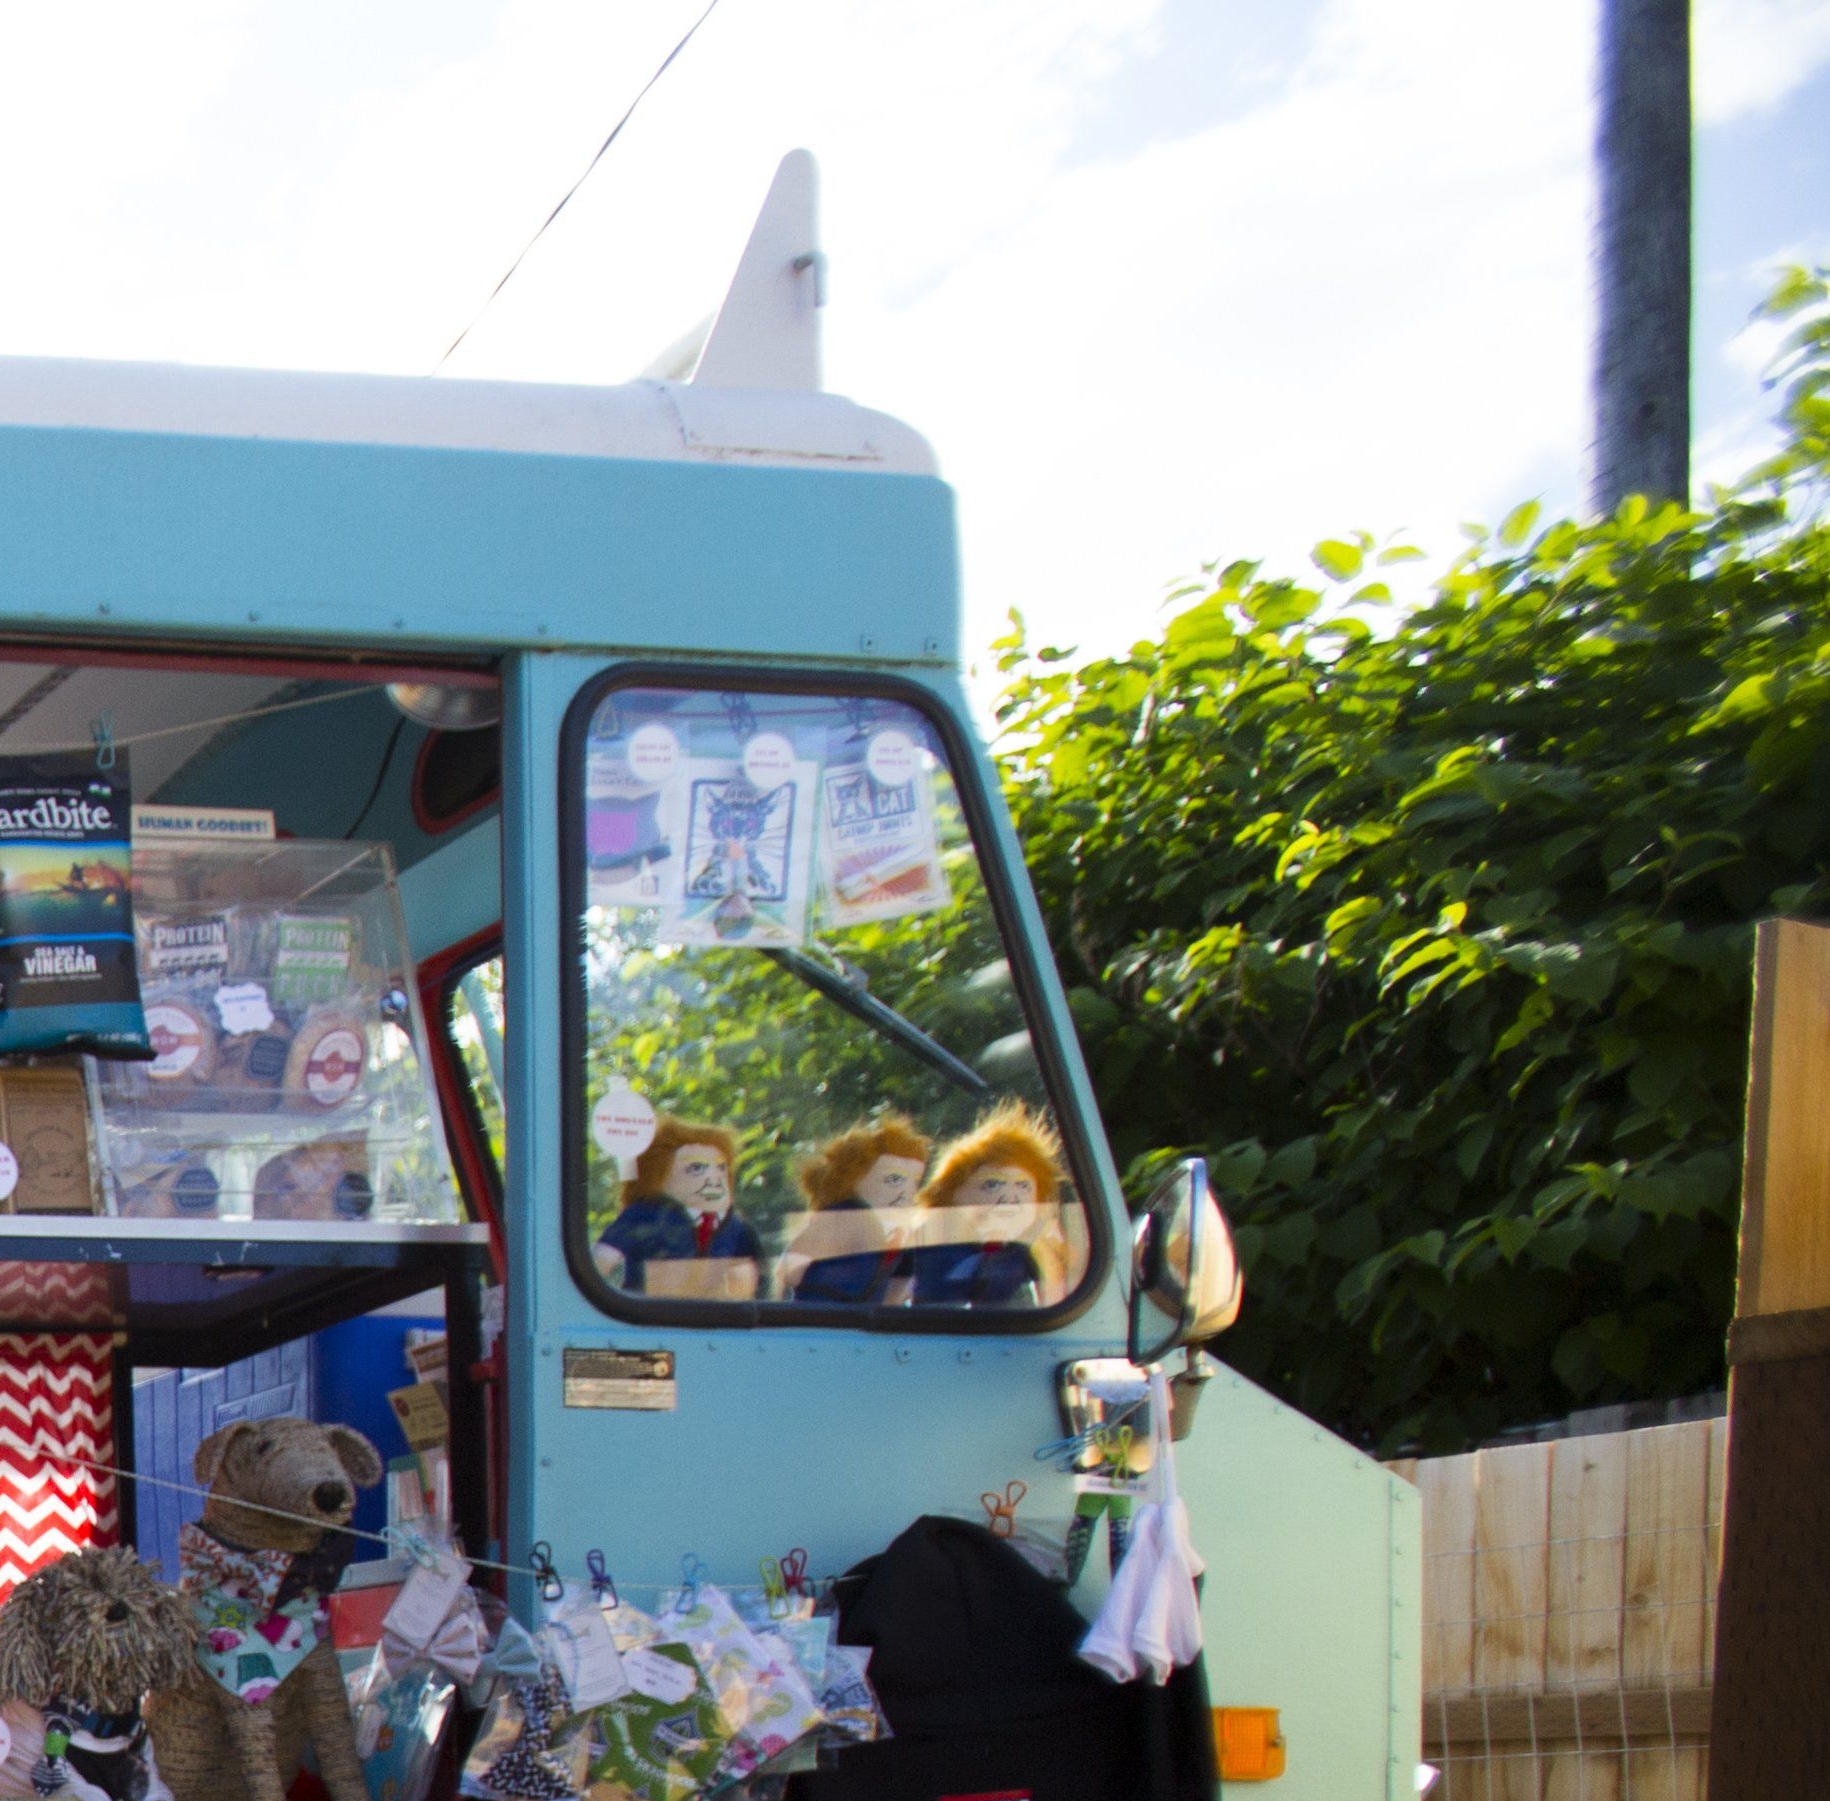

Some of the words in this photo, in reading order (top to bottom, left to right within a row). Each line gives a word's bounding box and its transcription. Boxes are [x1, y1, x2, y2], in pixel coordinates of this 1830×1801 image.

[137, 815, 194, 831] HUMAN
[154, 922, 226, 947] PROTEIN
[23, 954, 98, 976] VINEGAR
